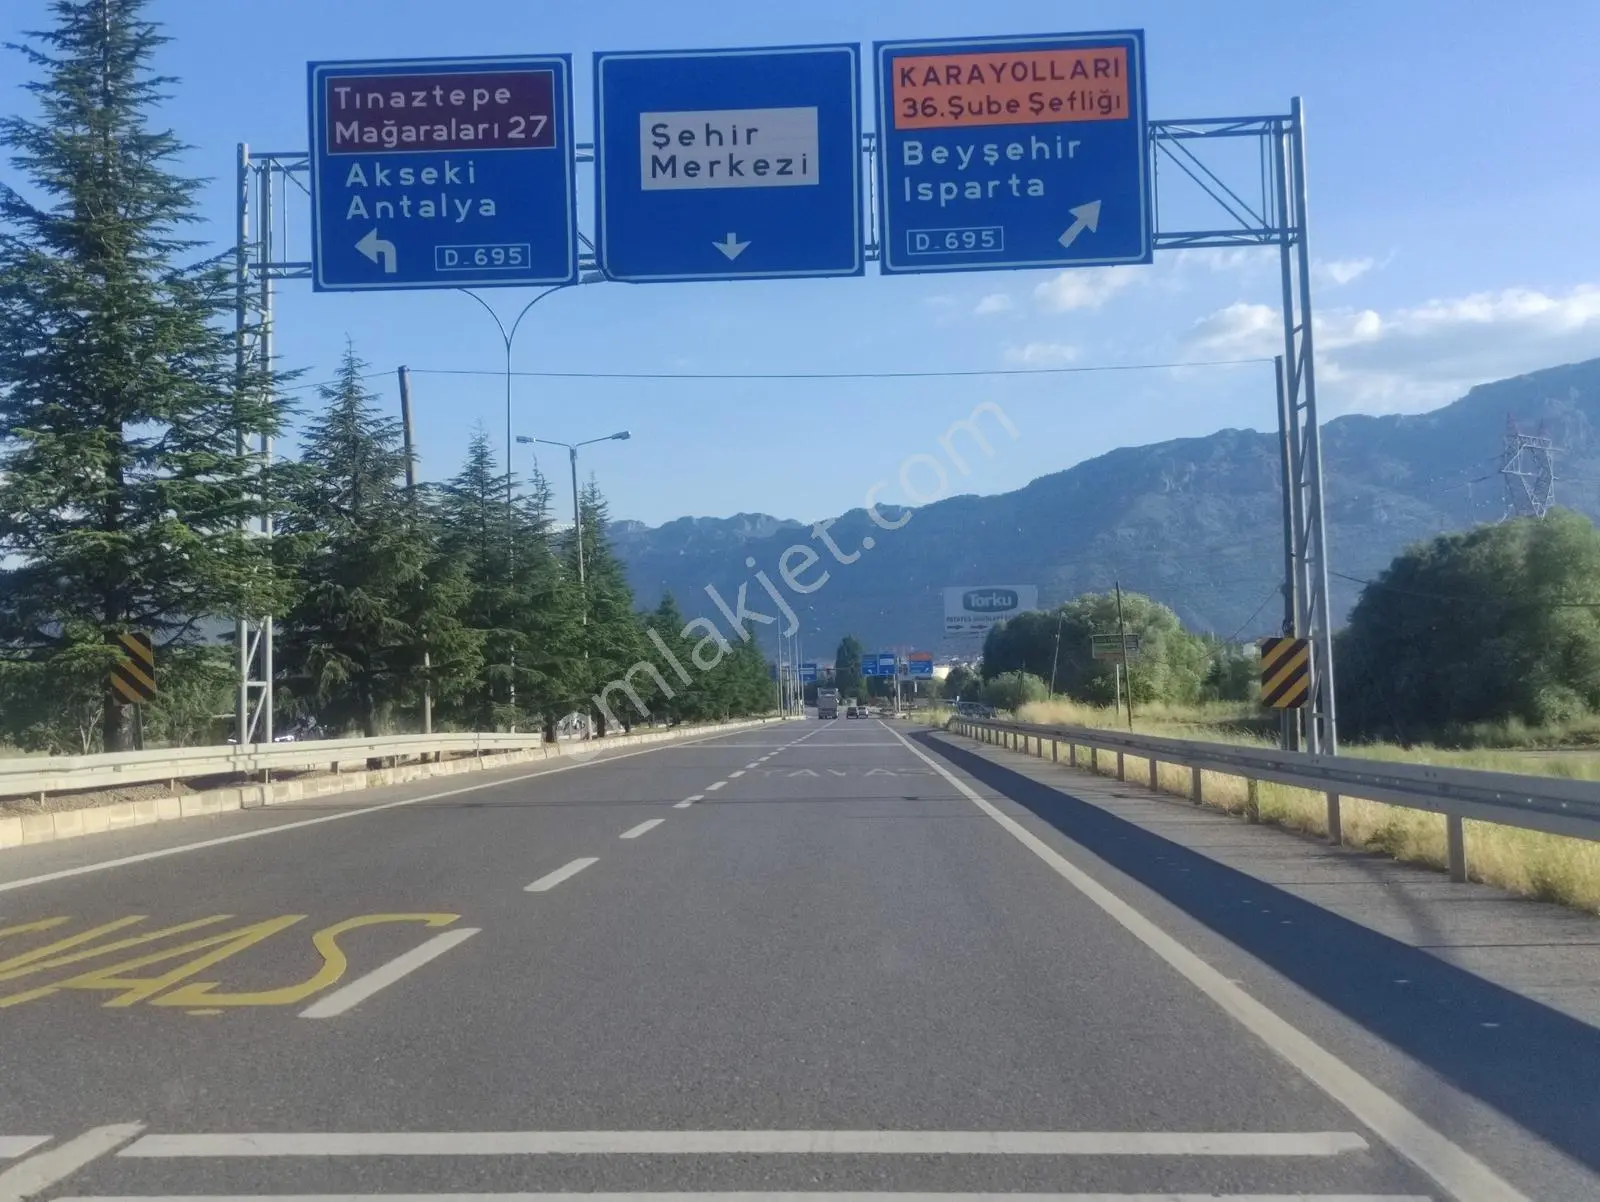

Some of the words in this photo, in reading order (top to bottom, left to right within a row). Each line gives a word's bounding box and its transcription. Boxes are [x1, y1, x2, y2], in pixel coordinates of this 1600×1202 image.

[900, 57, 1119, 88] KARAYOLLARI
[334, 85, 511, 110] Tınaztepe
[335, 117, 499, 148] Mağaraları
[507, 115, 548, 139] 27
[651, 122, 758, 150] Şehir
[651, 153, 807, 179] Merkezi
[903, 136, 1081, 170] Beyşehir
[346, 160, 476, 187] Akseki
[904, 173, 1044, 207] Isparta
[346, 193, 496, 222] Antalya
[969, 592, 1013, 607] Torku
